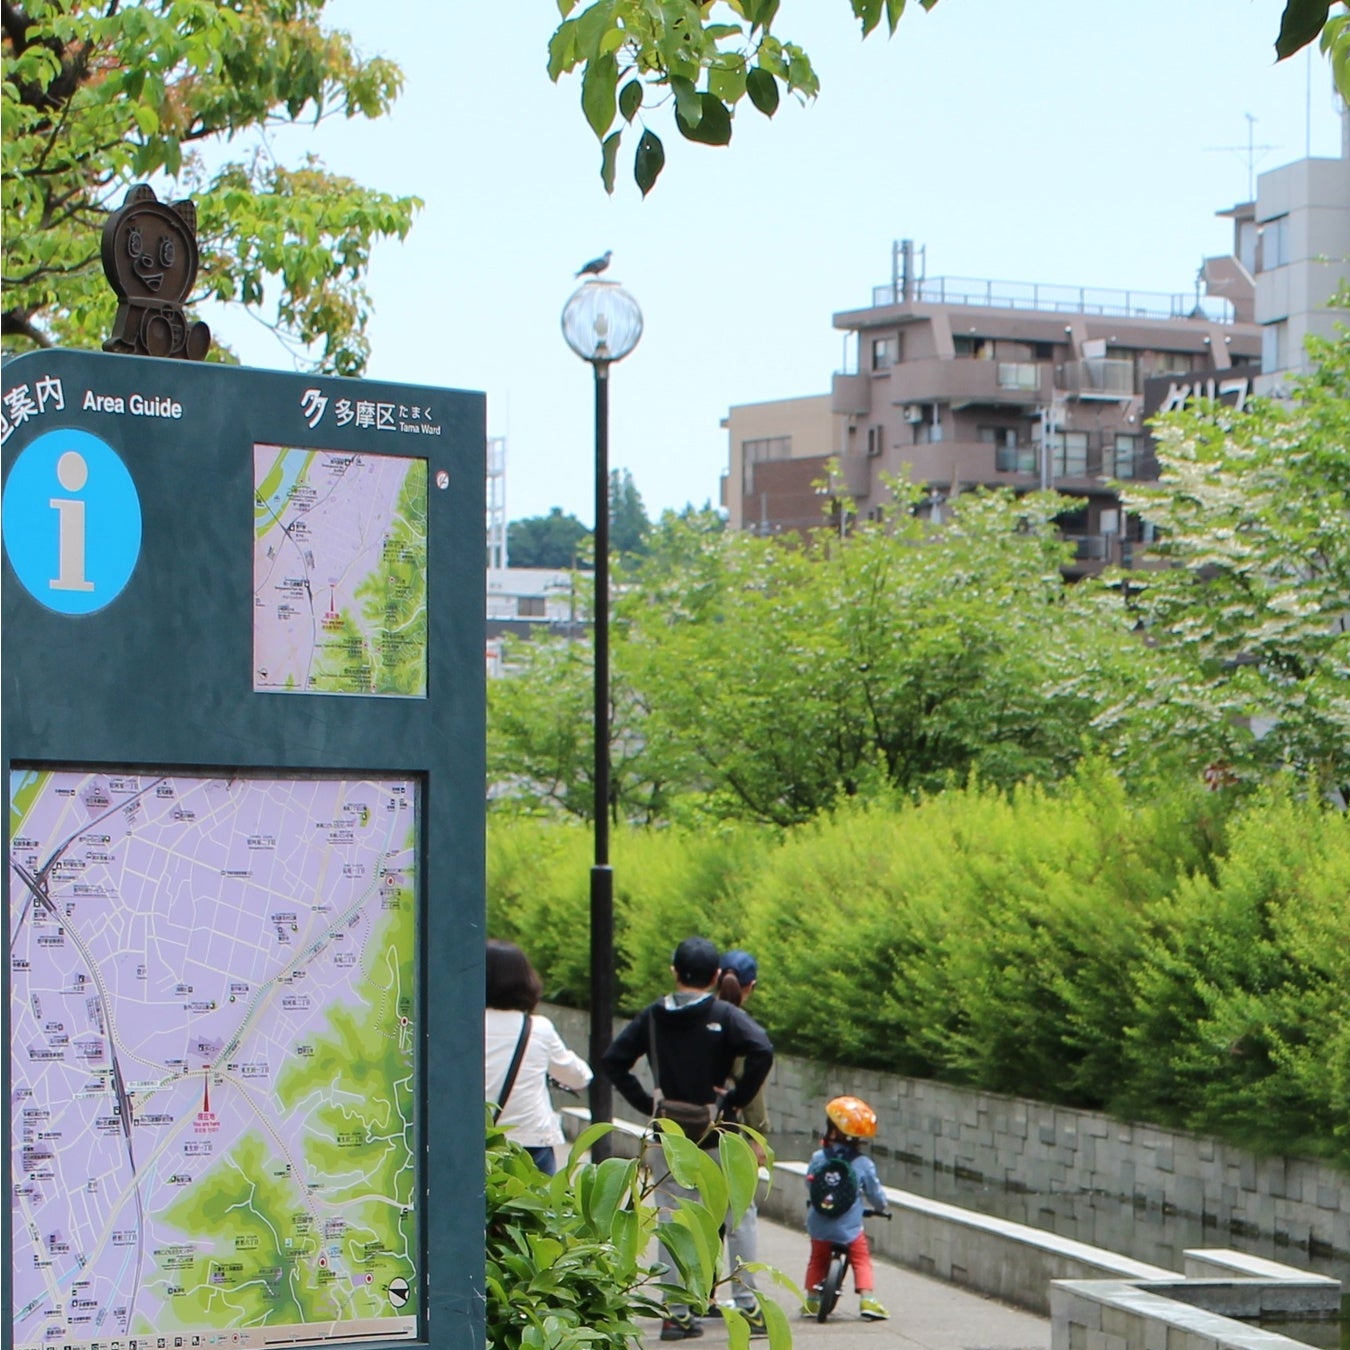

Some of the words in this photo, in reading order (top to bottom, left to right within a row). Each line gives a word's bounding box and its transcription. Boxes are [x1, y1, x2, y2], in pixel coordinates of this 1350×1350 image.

[83, 390, 125, 414] Area
[129, 394, 183, 419] Guide
[334, 398, 397, 431] 多摩区
[399, 404, 432, 421] たまく
[399, 421, 420, 433] Tama
[421, 423, 441, 435] Ward
